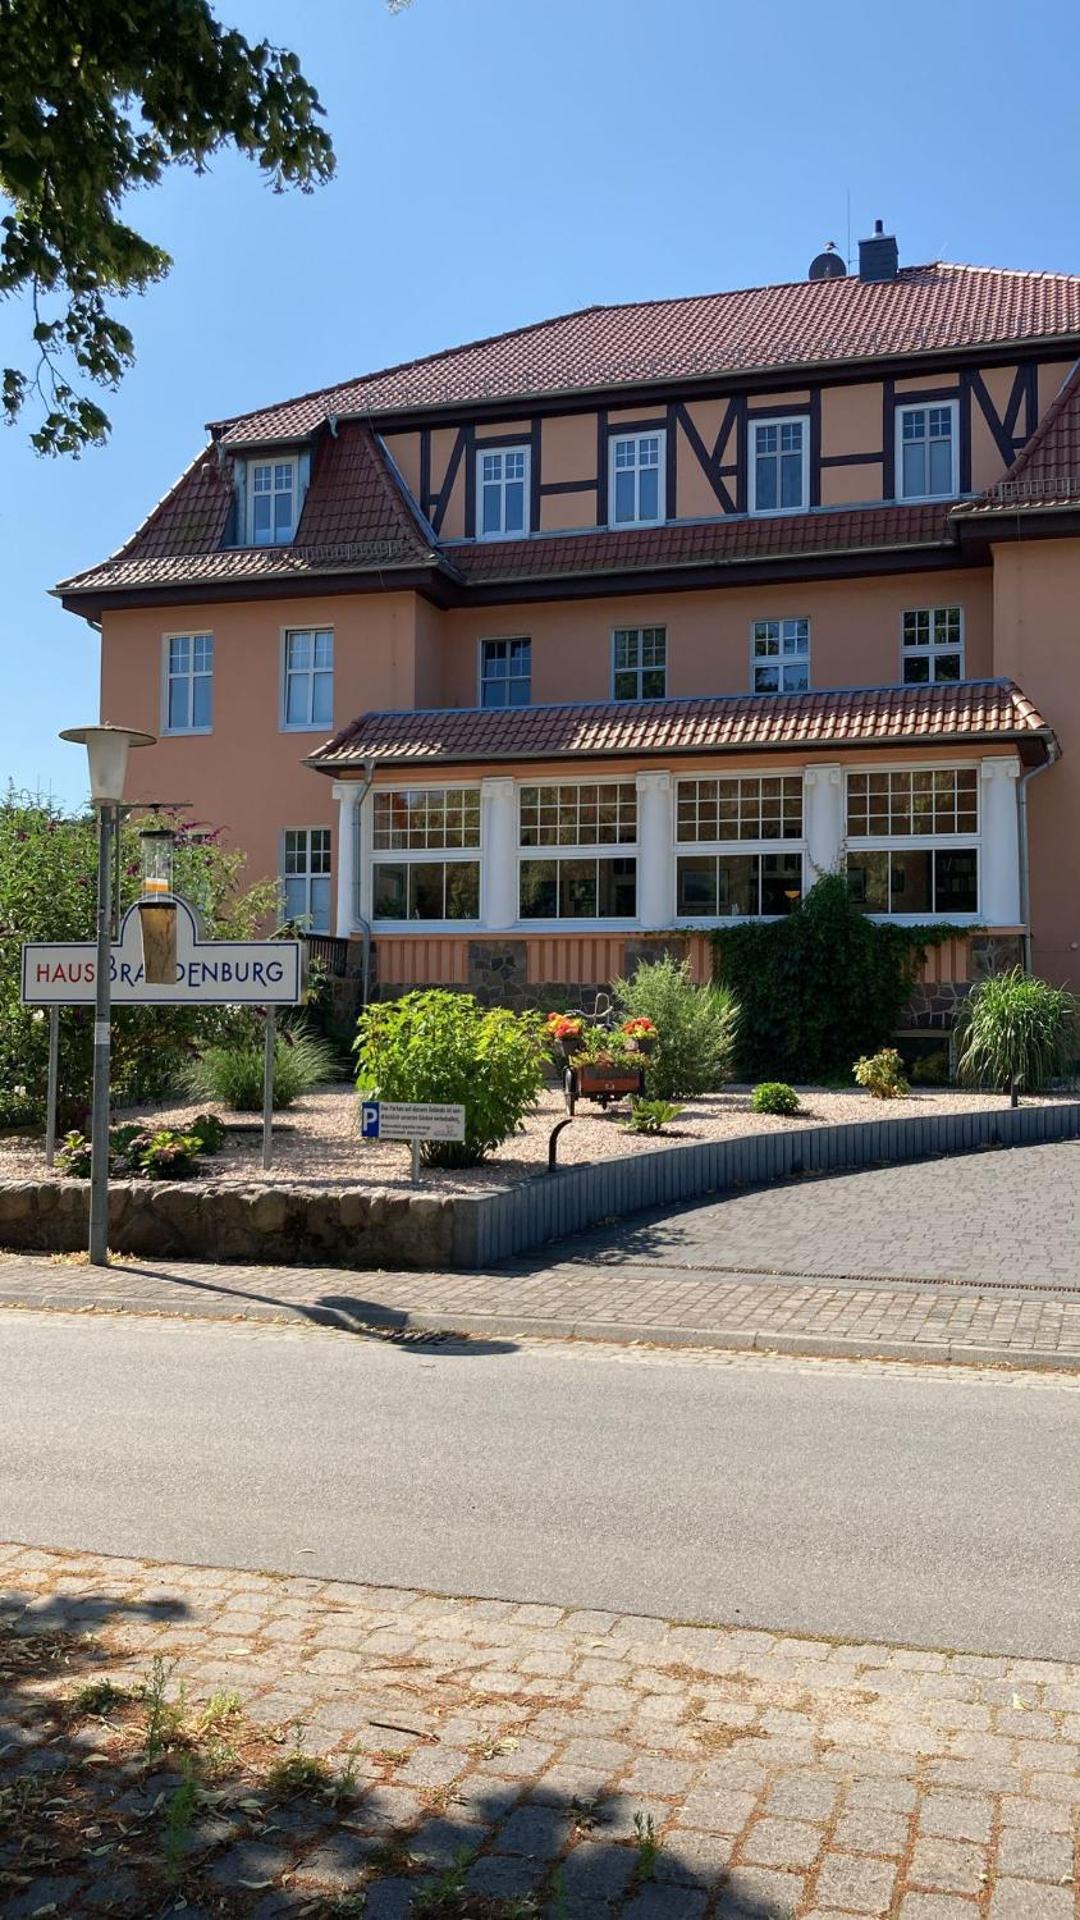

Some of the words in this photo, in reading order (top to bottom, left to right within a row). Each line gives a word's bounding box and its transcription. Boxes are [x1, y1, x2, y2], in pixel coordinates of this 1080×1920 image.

[36, 962, 95, 983] HAUS
[109, 955, 284, 987] BRADENBURG
[363, 1107, 378, 1131] P
